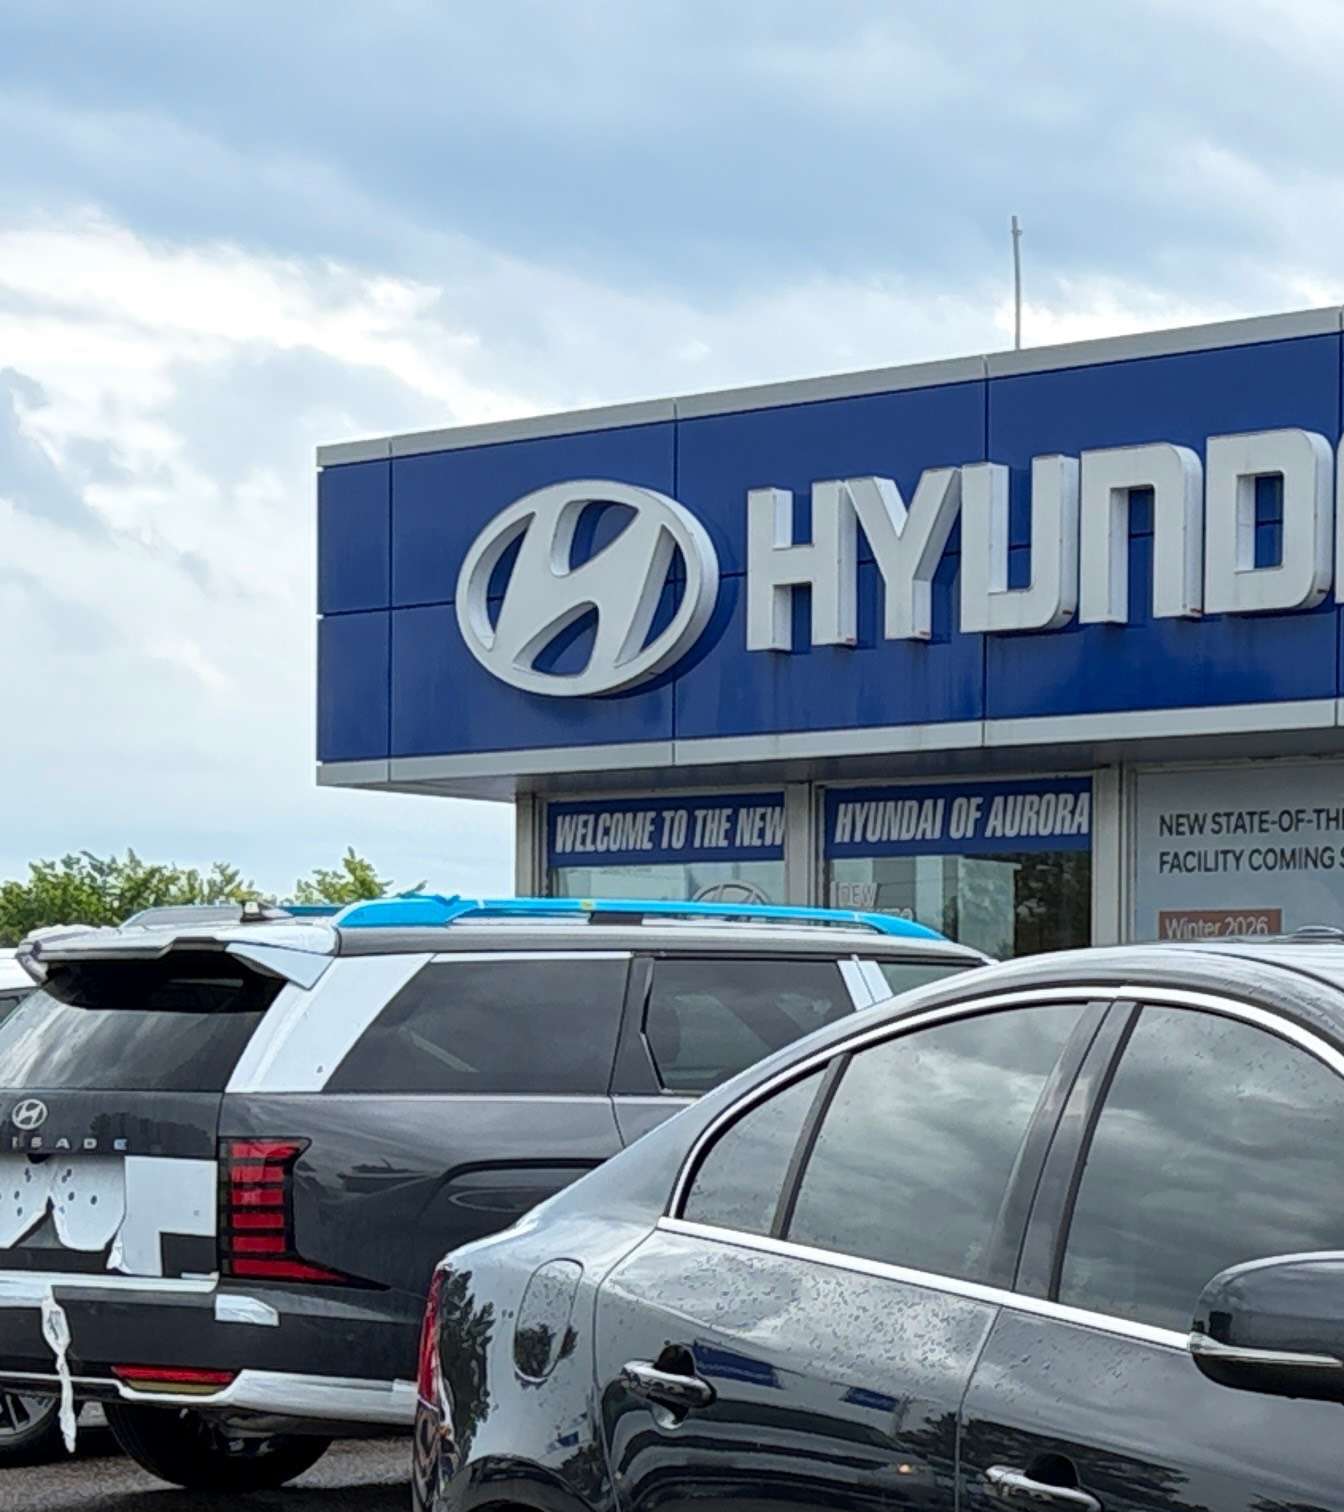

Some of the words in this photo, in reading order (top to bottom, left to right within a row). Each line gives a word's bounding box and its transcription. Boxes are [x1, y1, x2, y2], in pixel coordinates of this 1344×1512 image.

[555, 810, 657, 854] WELCOME
[660, 809, 688, 850] TO
[693, 808, 733, 849] THE
[735, 806, 785, 848] NEW
[834, 798, 944, 844] HYUNDAI
[950, 796, 984, 839] OF
[985, 792, 1091, 838] AURORA
[1159, 813, 1207, 837] NEW
[1159, 848, 1245, 874] FACILITY
[1249, 845, 1335, 872] COMING
[1165, 916, 1221, 939] Winter
[1225, 915, 1268, 937] 2026
